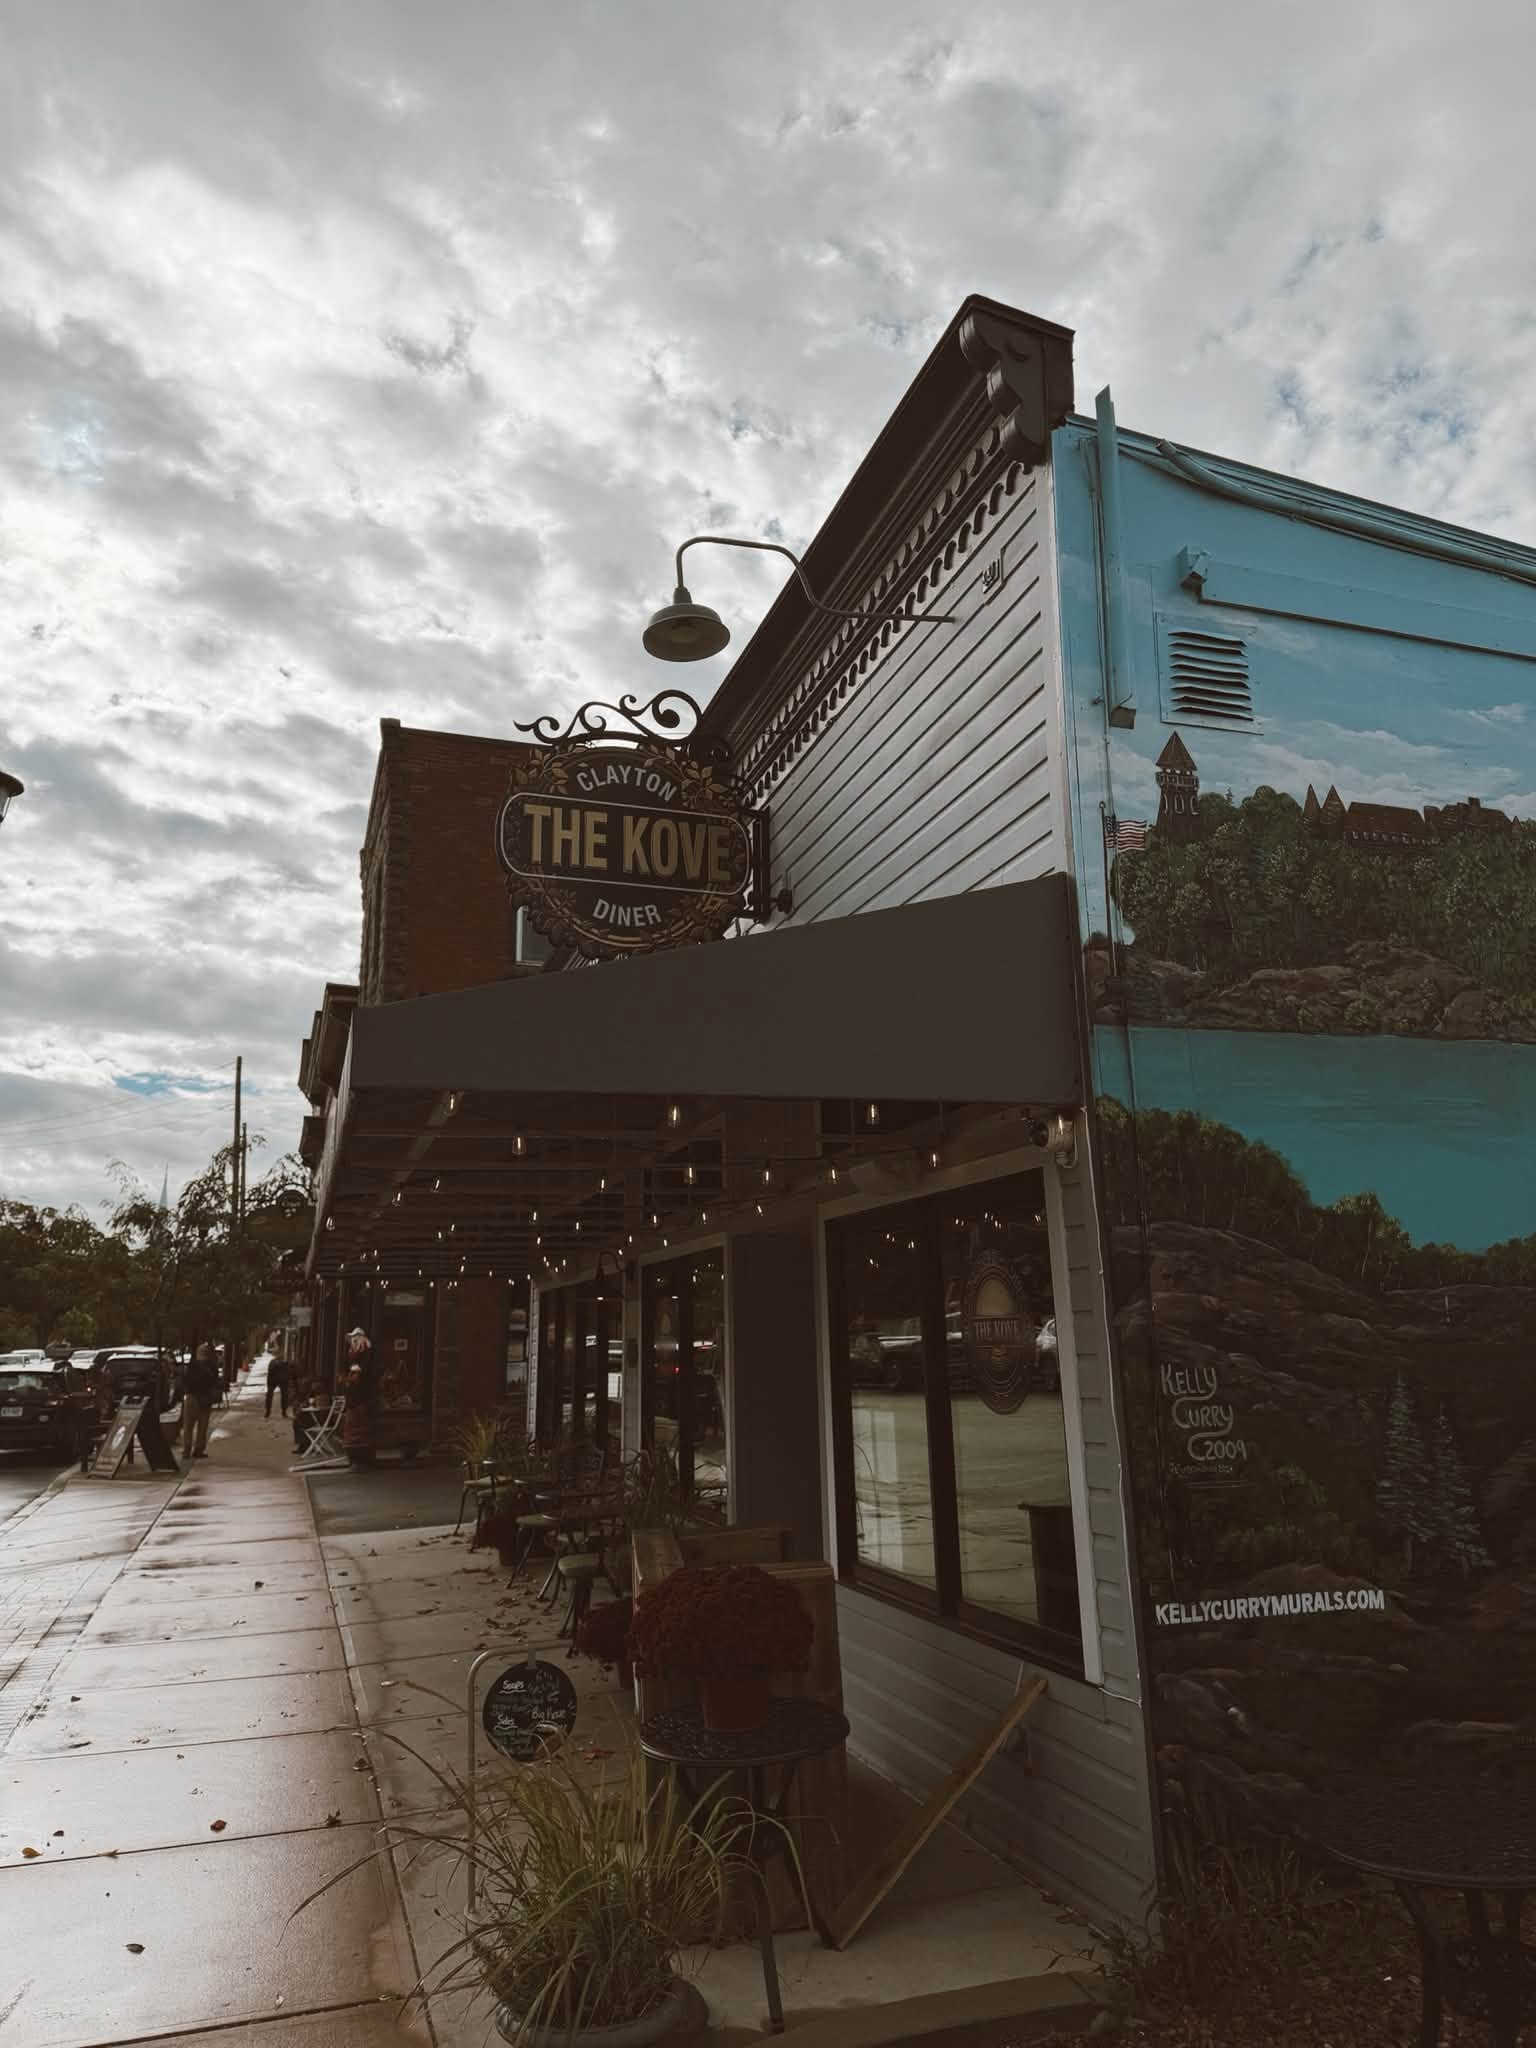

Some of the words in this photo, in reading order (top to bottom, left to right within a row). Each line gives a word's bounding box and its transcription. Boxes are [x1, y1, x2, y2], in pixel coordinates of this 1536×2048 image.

[576, 764, 677, 801] CLAYTON
[523, 803, 609, 871] THE
[622, 815, 732, 882] KOVE
[592, 898, 662, 927] DINER
[1155, 1589, 1385, 1625] KELLYCURRYMURALS.COM
